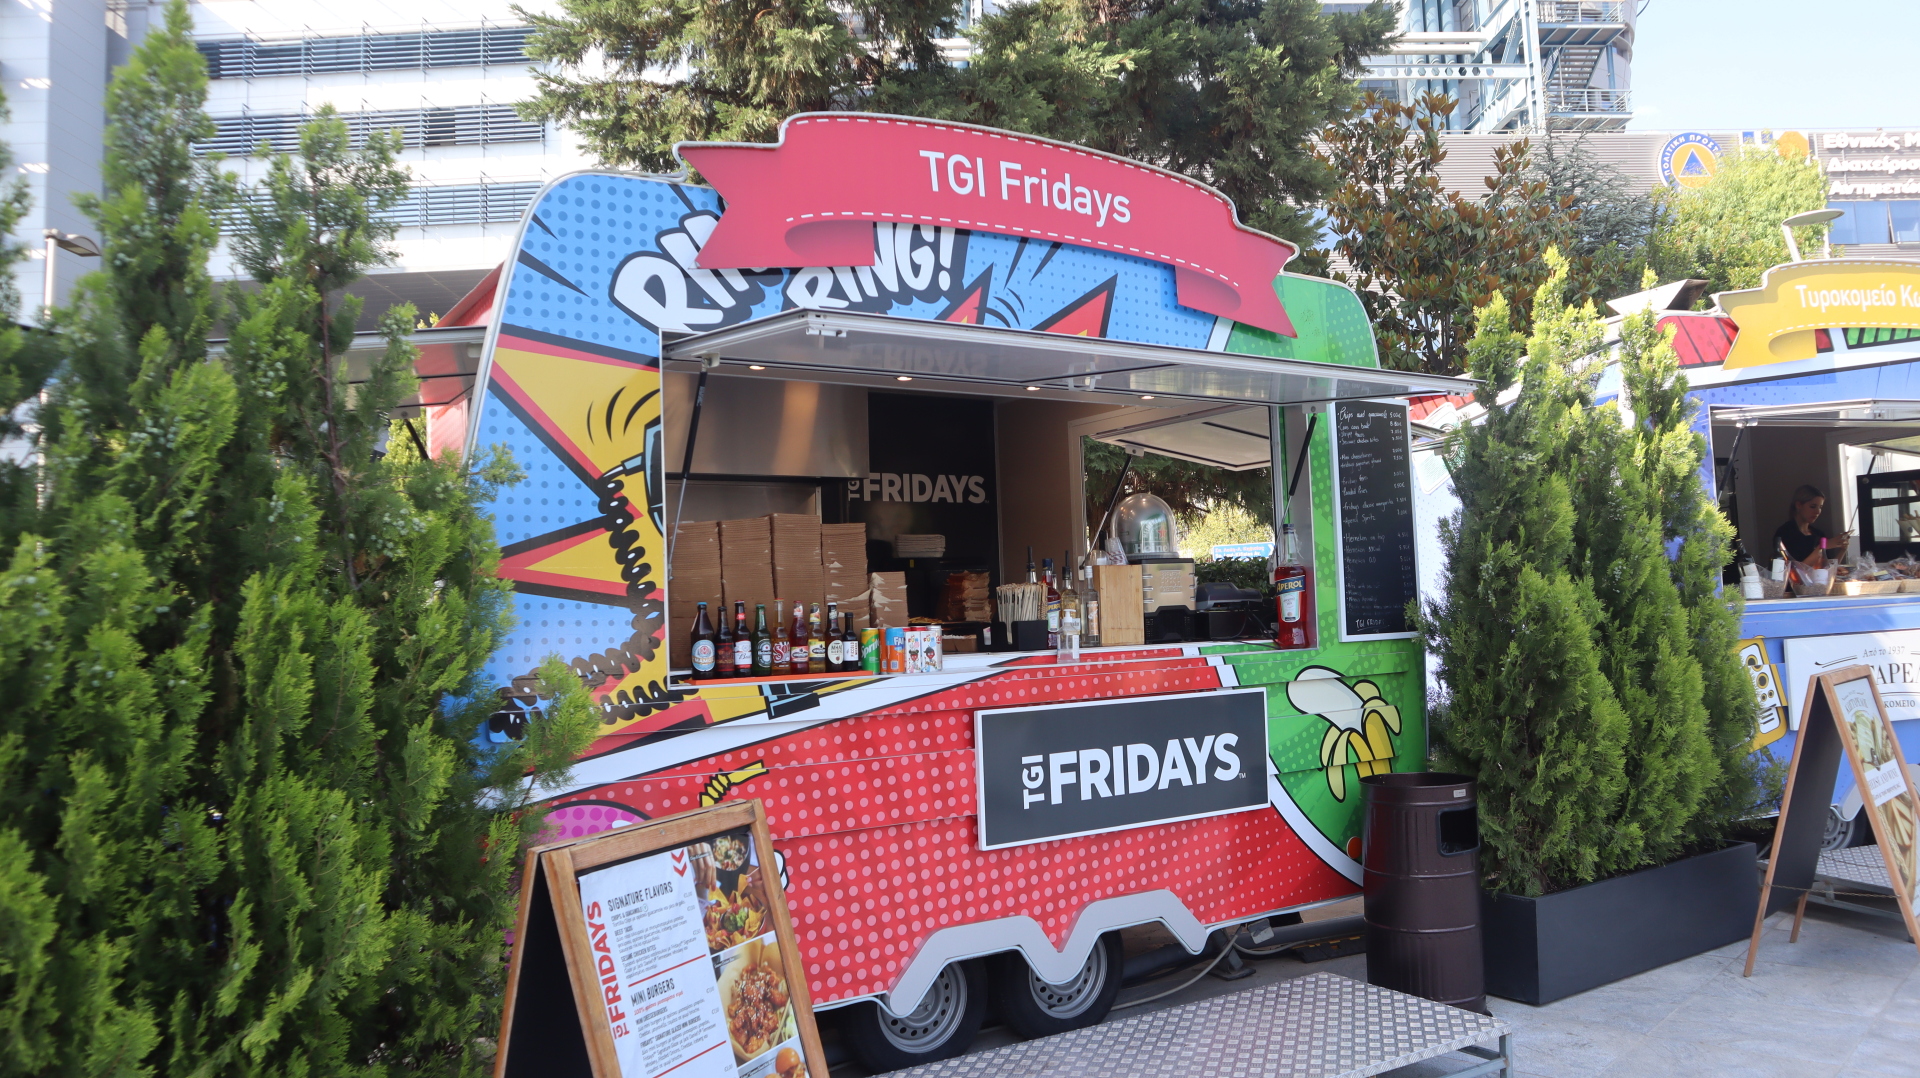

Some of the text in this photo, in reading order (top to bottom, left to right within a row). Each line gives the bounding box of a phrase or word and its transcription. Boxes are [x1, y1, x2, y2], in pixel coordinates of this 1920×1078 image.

[1823, 132, 1900, 150] Εθνικός
[1663, 136, 1685, 176] ΠΟΛΙΤΙΚΗ
[1827, 155, 1920, 174] Διαχείρισ
[919, 150, 1131, 227] TGI Fridays
[1828, 178, 1920, 198] Αντιμετώ
[1795, 284, 1896, 312] Τυροκομείο
[848, 472, 986, 504] TG FRIDAYS
[1276, 580, 1303, 592] APEROL
[861, 638, 880, 659] Sprit
[1863, 648, 1877, 658] Από
[1888, 646, 1905, 655] 1937
[1870, 662, 1920, 685] ΑΡΕ
[1021, 754, 1045, 810] TGI
[1049, 732, 1241, 805] FRIDAYS
[608, 881, 674, 912] SIGNATURE FLAVORS
[587, 901, 630, 1040] TGI FRIDAYS
[631, 978, 675, 1007] MINI BURGERS
